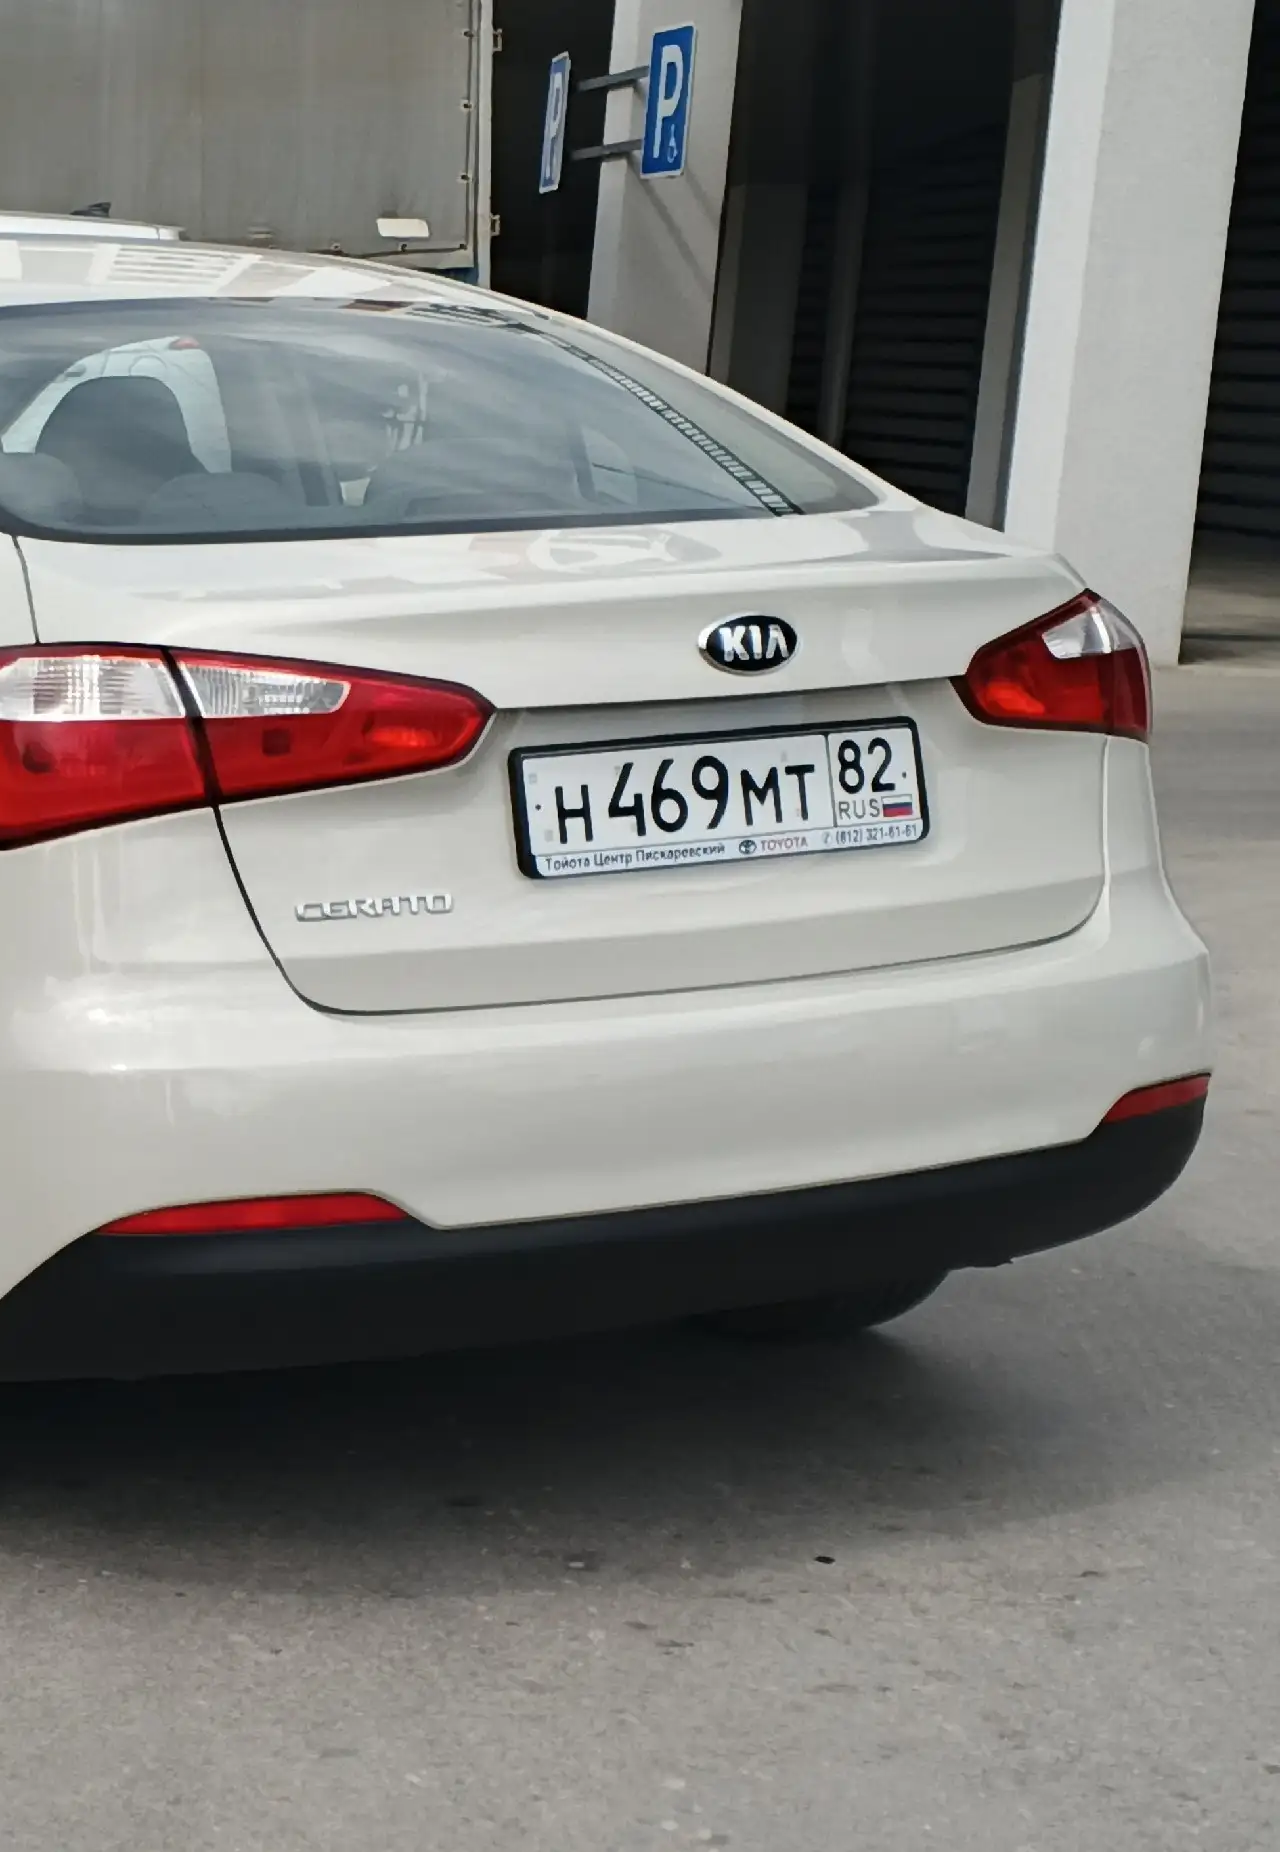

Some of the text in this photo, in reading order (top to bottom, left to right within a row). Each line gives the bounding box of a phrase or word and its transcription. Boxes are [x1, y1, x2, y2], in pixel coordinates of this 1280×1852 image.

[652, 44, 683, 159] P
[545, 72, 563, 180] P
[718, 624, 790, 662] KIA
[837, 737, 896, 794] 82
[838, 798, 881, 820] RUS
[593, 852, 633, 868] Центр
[760, 836, 809, 851] TOYOTA
[295, 893, 454, 922] CERATO
